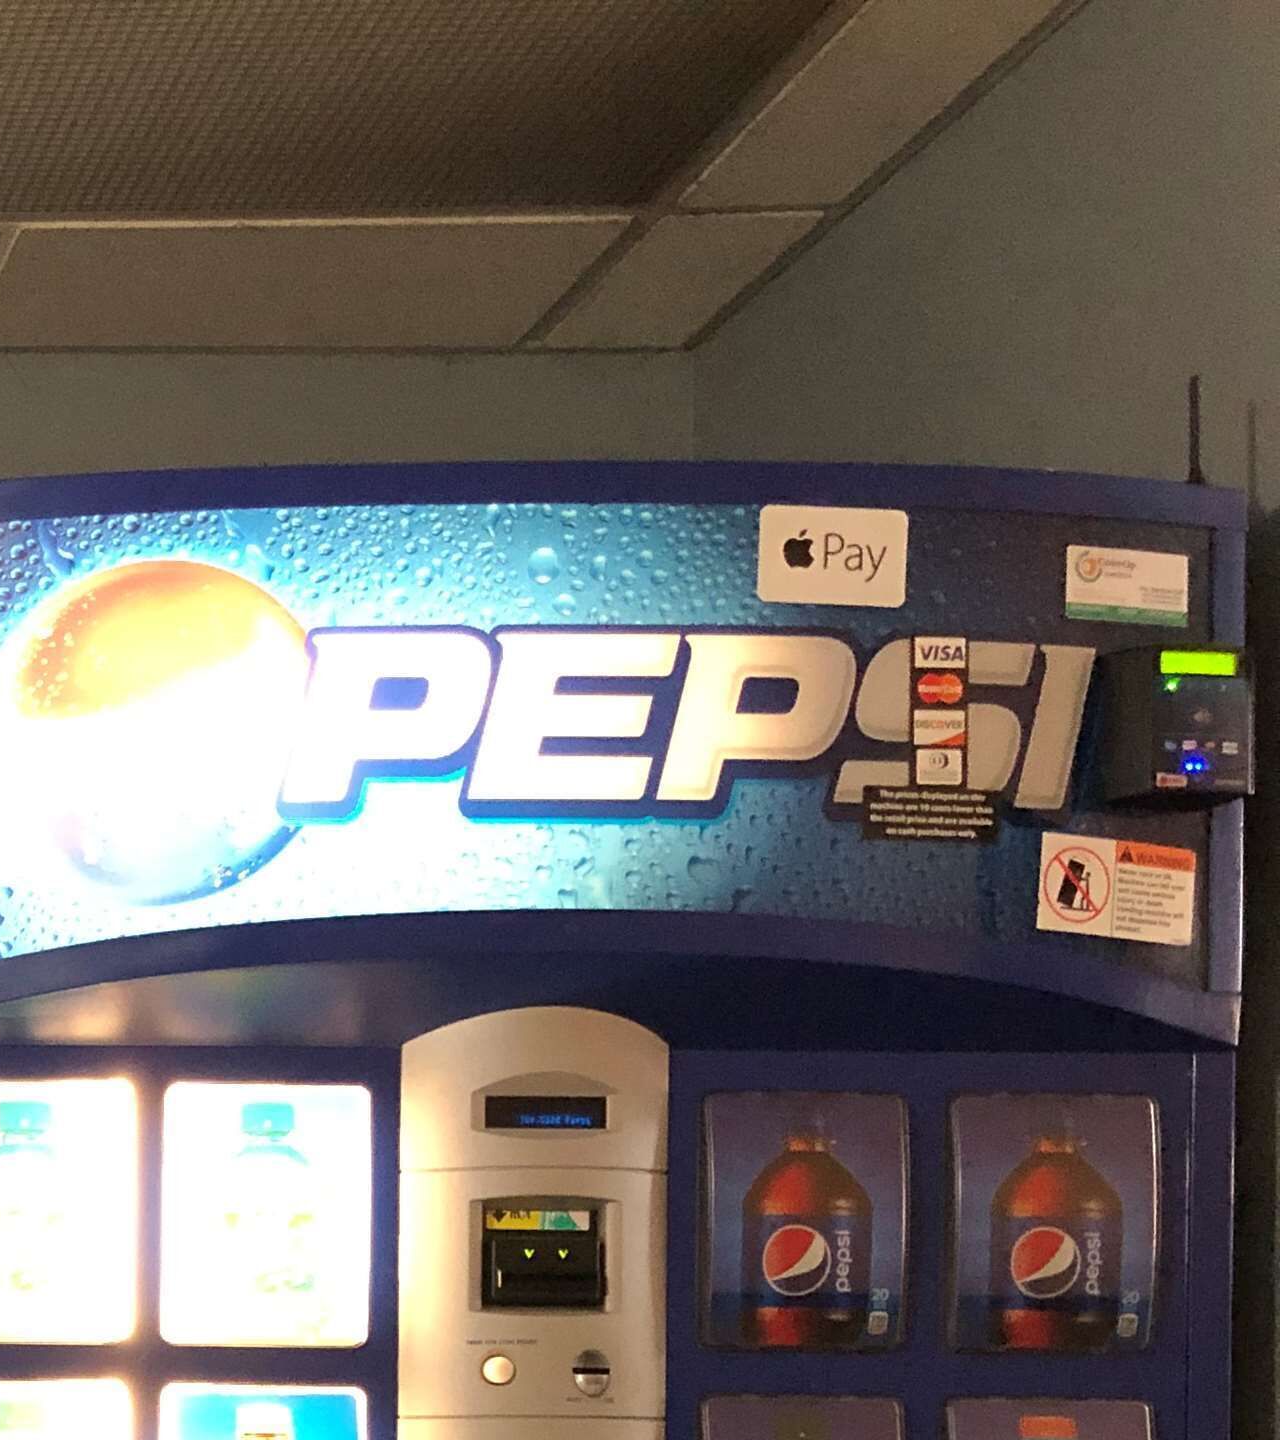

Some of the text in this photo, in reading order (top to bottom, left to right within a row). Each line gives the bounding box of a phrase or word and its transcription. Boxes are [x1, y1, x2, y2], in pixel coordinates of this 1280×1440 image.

[823, 531, 887, 583] Pay
[920, 645, 965, 661] VISA
[276, 628, 1096, 812] PEPSI
[915, 719, 964, 730] DISCOVER
[834, 1229, 853, 1294] pepsi
[1084, 1230, 1103, 1296] pepsi
